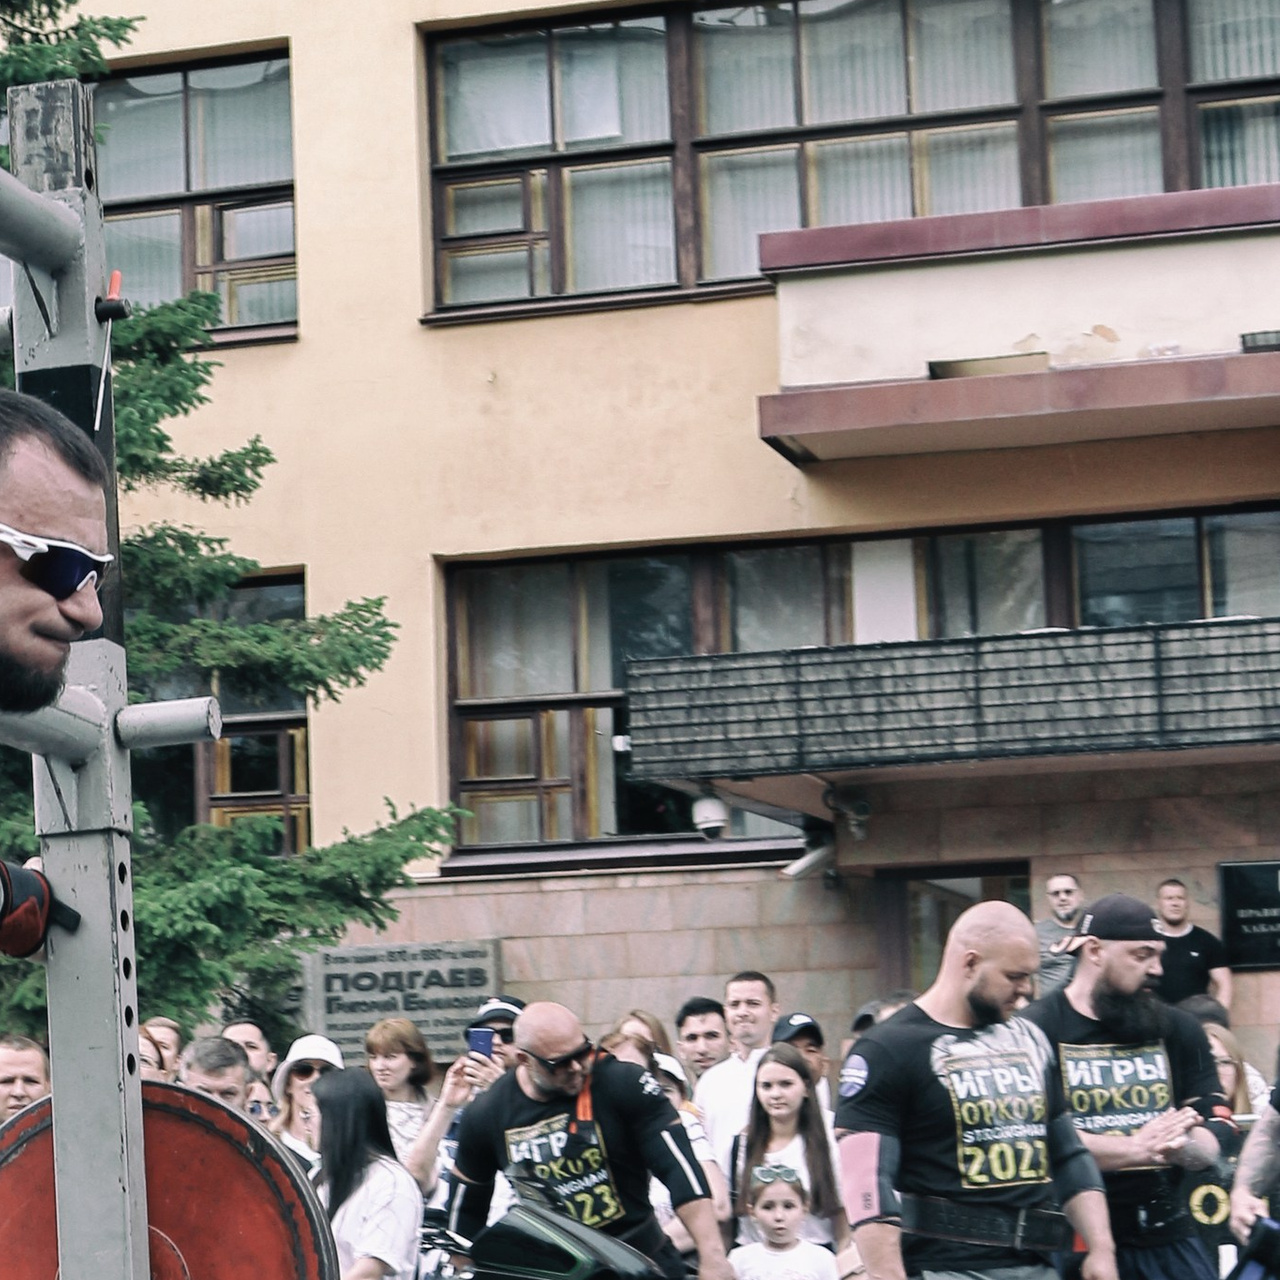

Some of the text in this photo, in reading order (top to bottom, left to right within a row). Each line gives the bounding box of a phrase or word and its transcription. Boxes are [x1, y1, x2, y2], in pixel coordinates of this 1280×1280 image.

[324, 967, 489, 993] ПОДГАЕВ
[950, 1066, 1042, 1099] ИГРЫ
[1066, 1054, 1168, 1086] ИГРЫ
[961, 1095, 1045, 1125] ОРКОВ
[1071, 1083, 1170, 1113] ОРКОВ
[509, 1131, 598, 1163] ИГР
